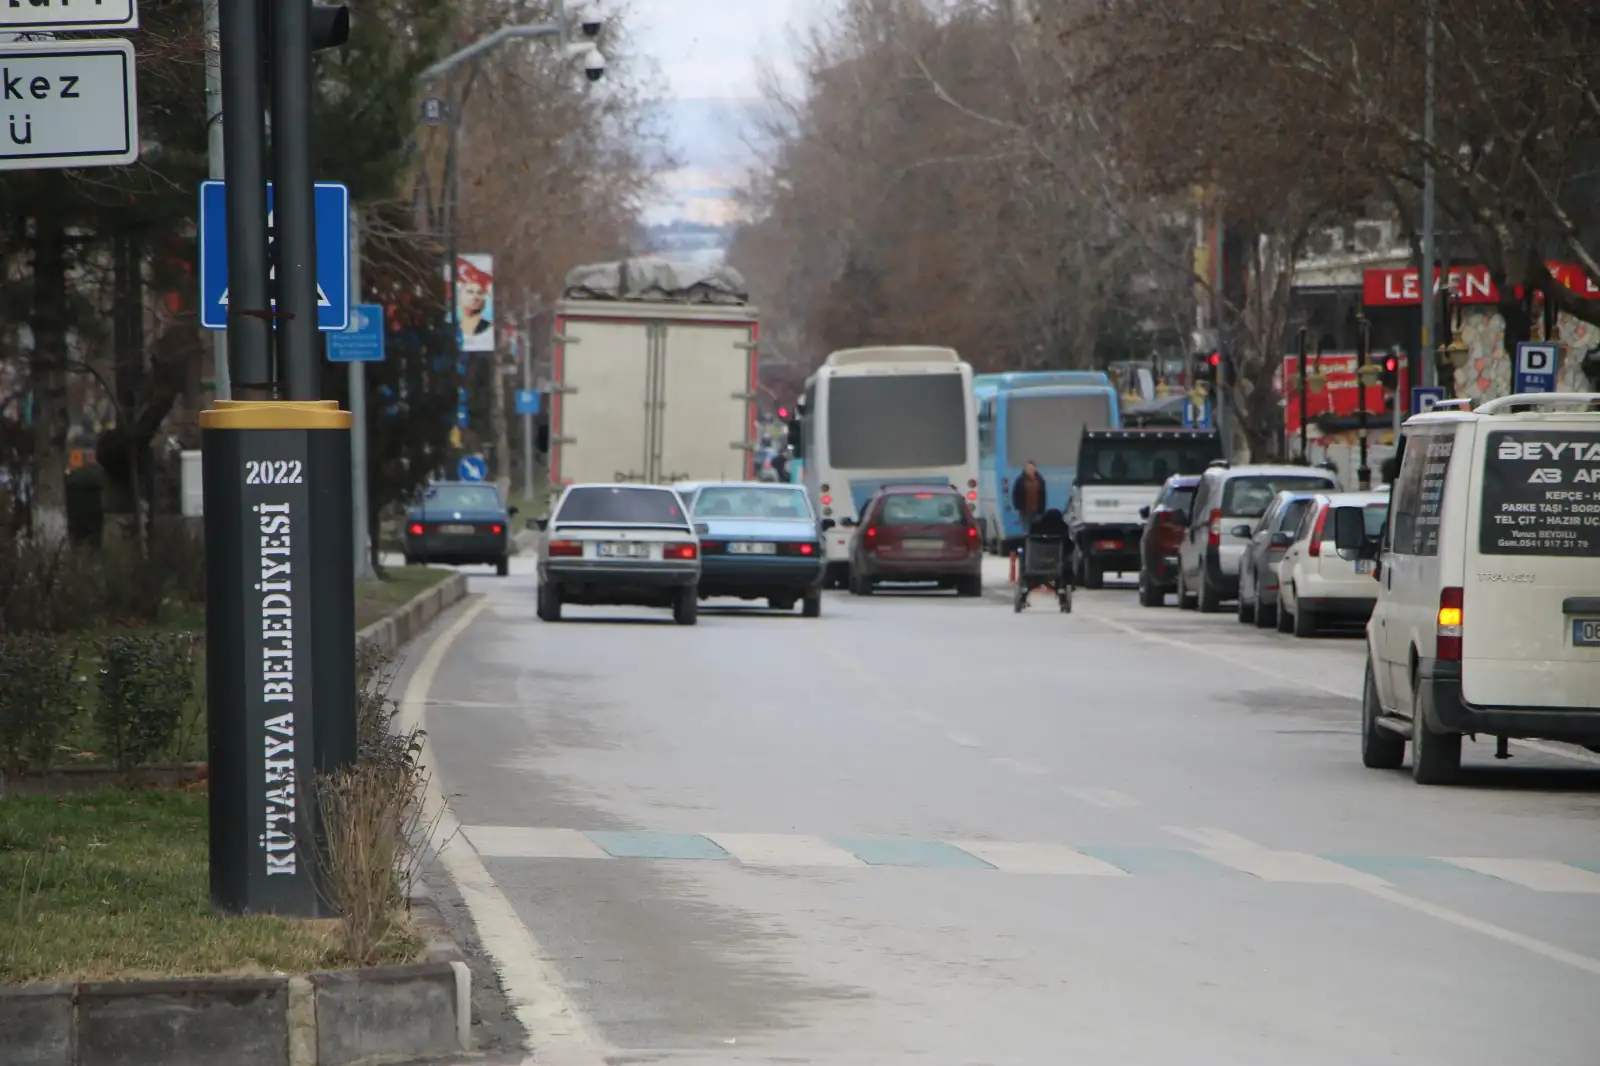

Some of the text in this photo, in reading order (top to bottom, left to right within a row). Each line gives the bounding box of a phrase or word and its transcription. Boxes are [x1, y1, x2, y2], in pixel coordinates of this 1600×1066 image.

[3, 68, 80, 100] kez
[9, 114, 32, 144] ü
[1527, 351, 1547, 369] D
[246, 460, 303, 485] 2022
[1527, 468, 1562, 483] AB
[1545, 491, 1583, 501] KEPÇE
[1502, 503, 1537, 512] PARKE
[1539, 503, 1562, 514] TAŞI
[1494, 515, 1516, 524] TEL
[1546, 516, 1581, 525] HAZIR
[1544, 540, 1561, 548] 917
[1563, 540, 1574, 548] 31
[253, 502, 297, 876] KÜTAHYA BELEDİYESİ
